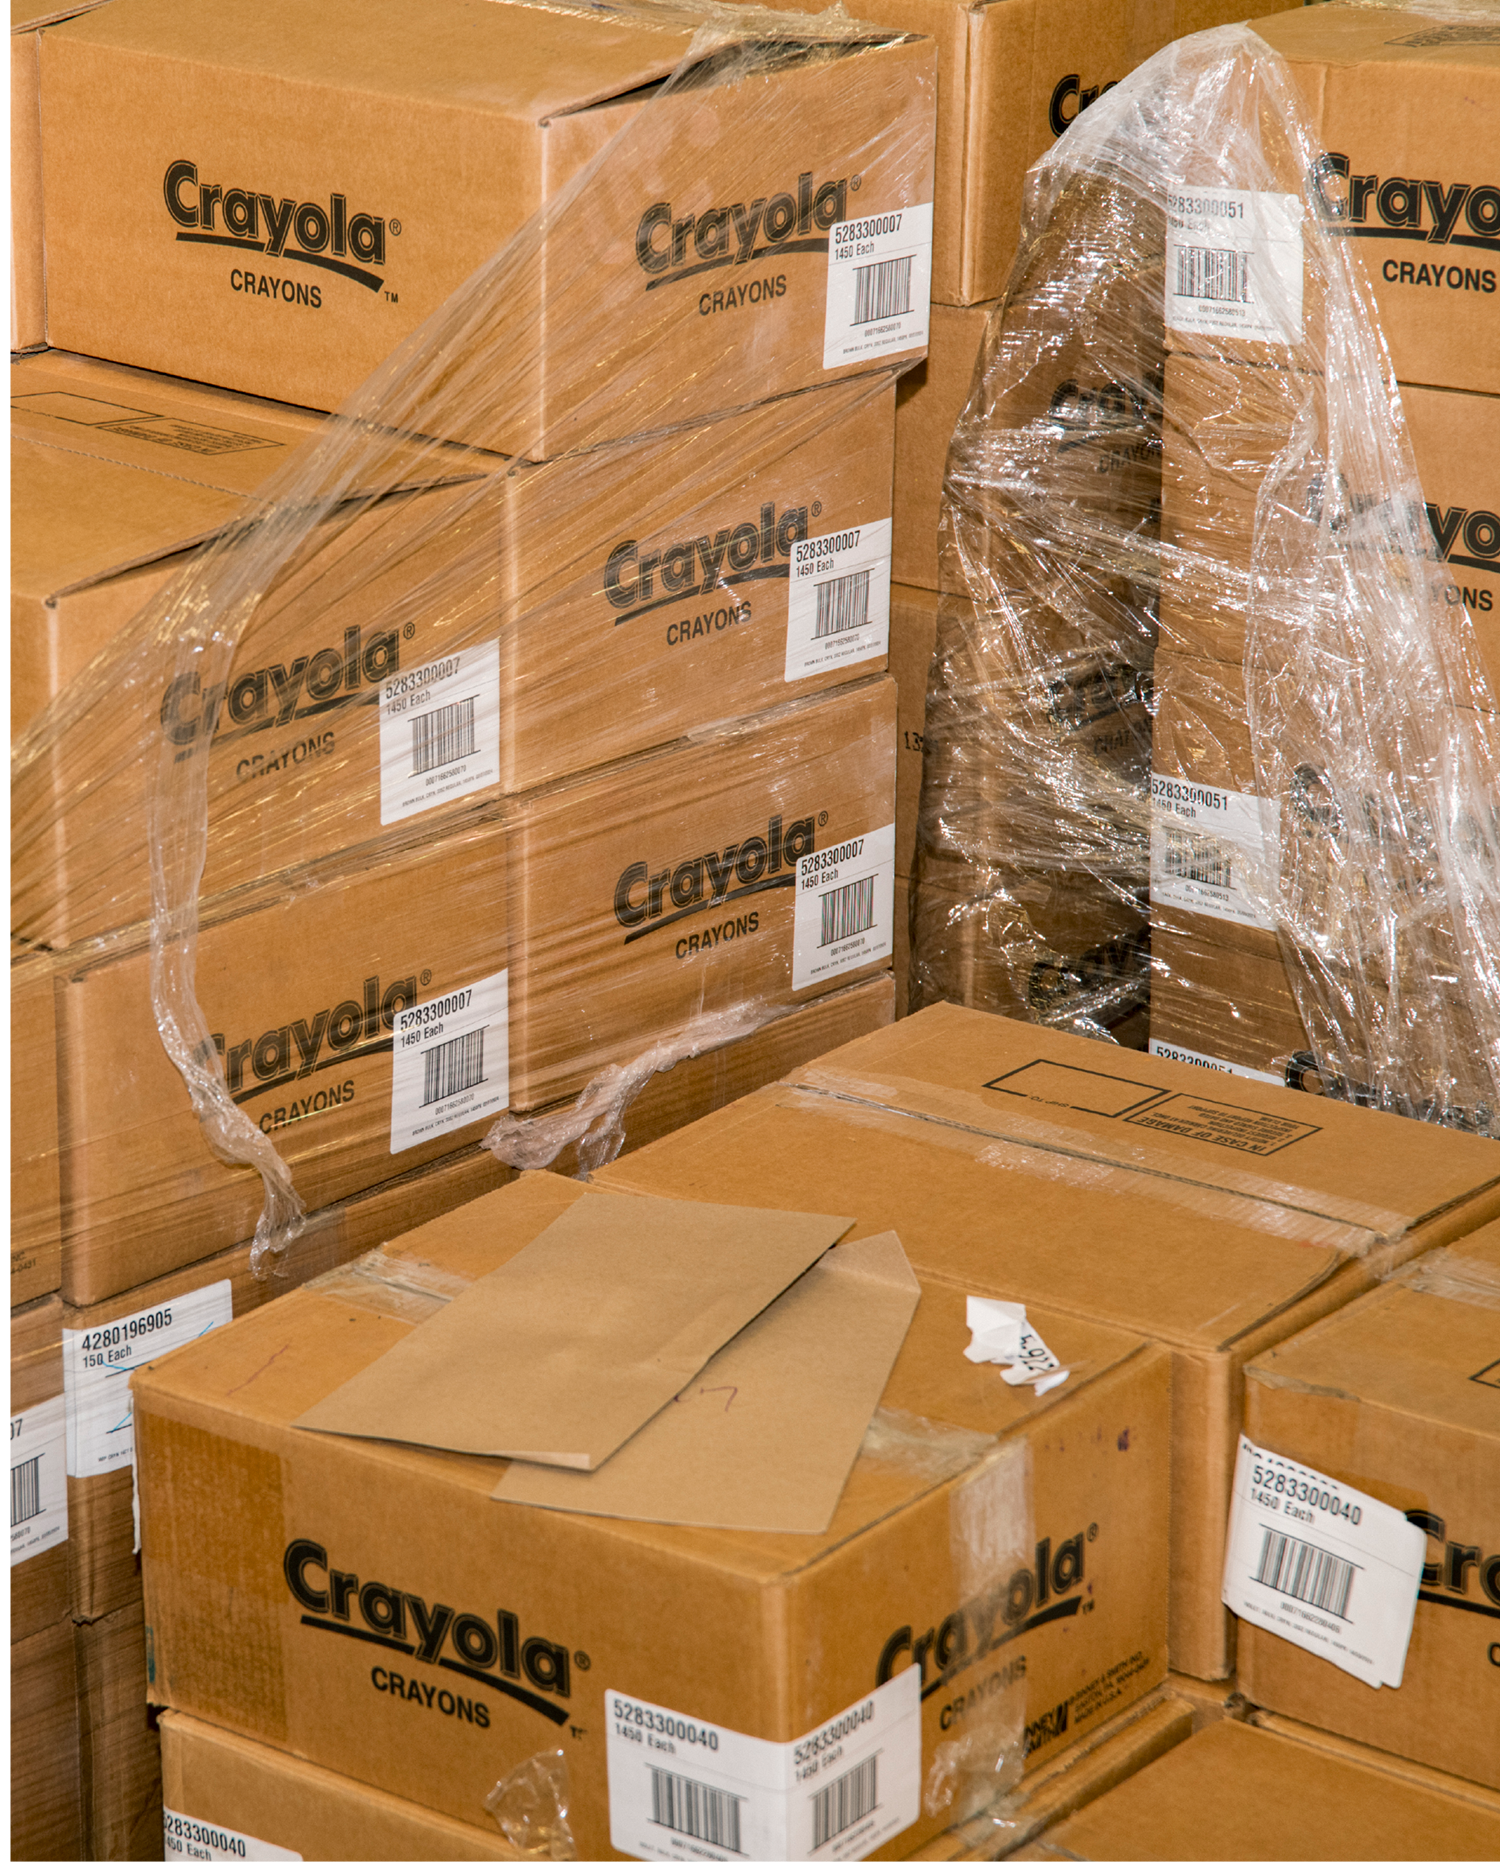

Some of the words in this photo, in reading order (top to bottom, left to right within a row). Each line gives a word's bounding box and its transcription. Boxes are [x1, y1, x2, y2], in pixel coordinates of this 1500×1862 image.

[835, 213, 903, 245] 5283300007
[835, 246, 854, 260] 1450
[856, 241, 874, 257] Each
[230, 268, 322, 309] CRAYONS
[699, 273, 787, 317] CRAYONS
[1382, 259, 1497, 293] CRAYONS
[796, 530, 861, 563] 5283300007
[796, 563, 814, 578] 1450
[817, 558, 834, 573] Each
[666, 600, 752, 646] CRAYONS
[386, 656, 461, 700] 5283300007
[386, 698, 407, 716] 1450
[410, 690, 431, 708] Each
[236, 731, 336, 780] CRAYONS
[1175, 802, 1197, 818] Each
[801, 838, 864, 876] 5283300007
[801, 875, 819, 891] 1450
[821, 868, 839, 884] Each
[675, 911, 760, 960] CRAYONS
[400, 988, 473, 1032] 5283300007
[400, 1030, 421, 1048] 1450
[424, 1022, 444, 1040] Each
[259, 1079, 355, 1135] CRAYONS
[82, 1308, 173, 1351] 4280196905
[83, 1352, 104, 1368] 150
[107, 1344, 132, 1363] Each
[1250, 1487, 1281, 1510] 1450
[1283, 1500, 1315, 1525] Each
[1253, 1464, 1362, 1526] 5283300040
[371, 1665, 491, 1728] CRAYONS
[613, 1698, 719, 1751] 5283300040
[615, 1722, 643, 1744] 1450
[647, 1735, 676, 1754] Each
[794, 1700, 874, 1765] 5283300040
[795, 1761, 818, 1781] 1450
[822, 1745, 843, 1768] Each
[187, 1842, 212, 1862] Each
